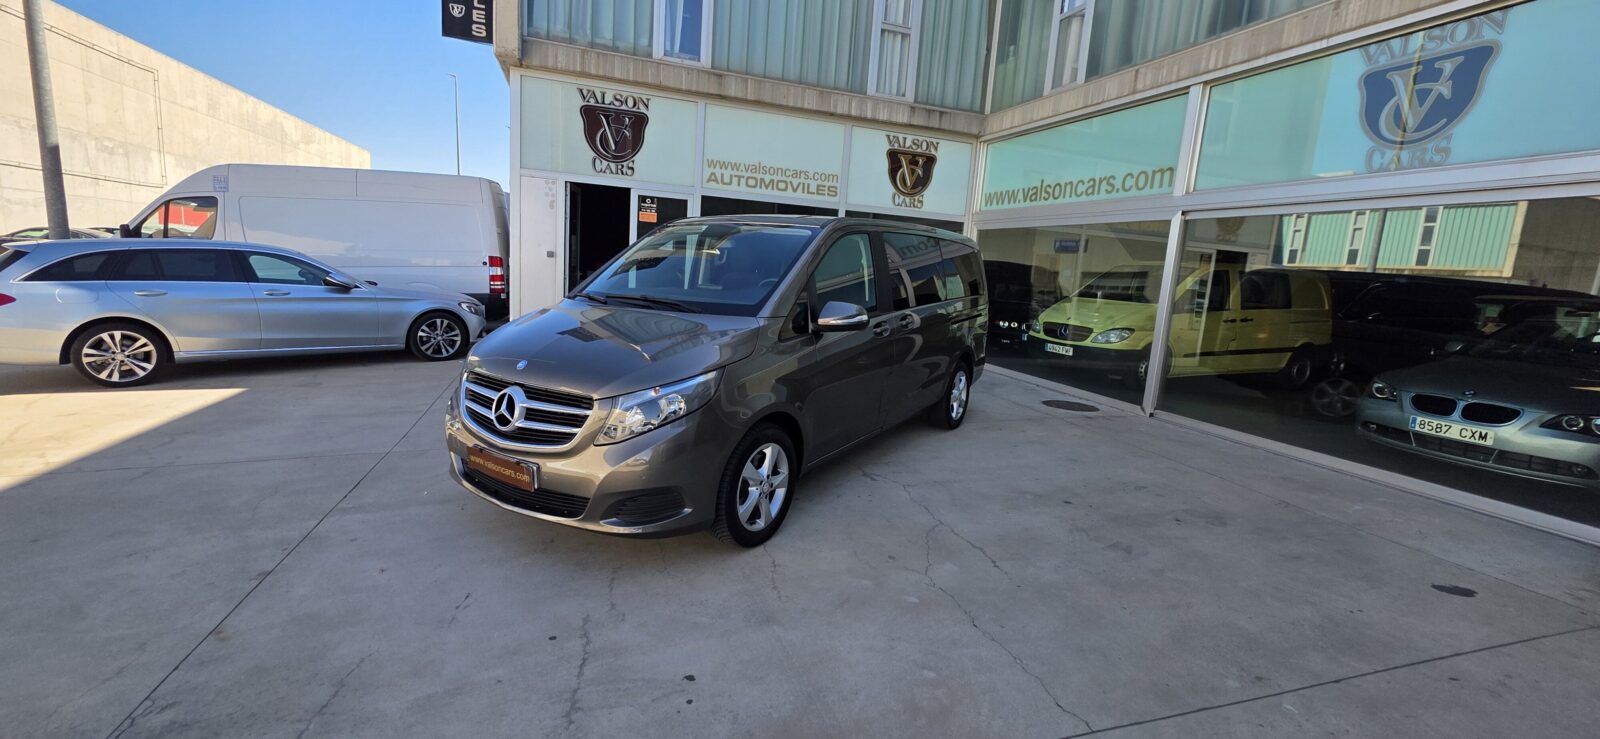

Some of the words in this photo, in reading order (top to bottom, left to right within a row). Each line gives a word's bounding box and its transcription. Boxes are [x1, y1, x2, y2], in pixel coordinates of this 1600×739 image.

[576, 87, 651, 112] VALSON
[885, 134, 940, 154] VALSON
[1364, 132, 1454, 174] CARS
[591, 155, 635, 177] CARS
[706, 158, 839, 184] www.valsoncars.com
[706, 171, 838, 198] AUTOMOVILES
[984, 165, 1175, 208] www.valsoncars.com
[892, 191, 925, 209] CARS
[1418, 419, 1452, 435] 8587
[1459, 427, 1489, 443] CXM
